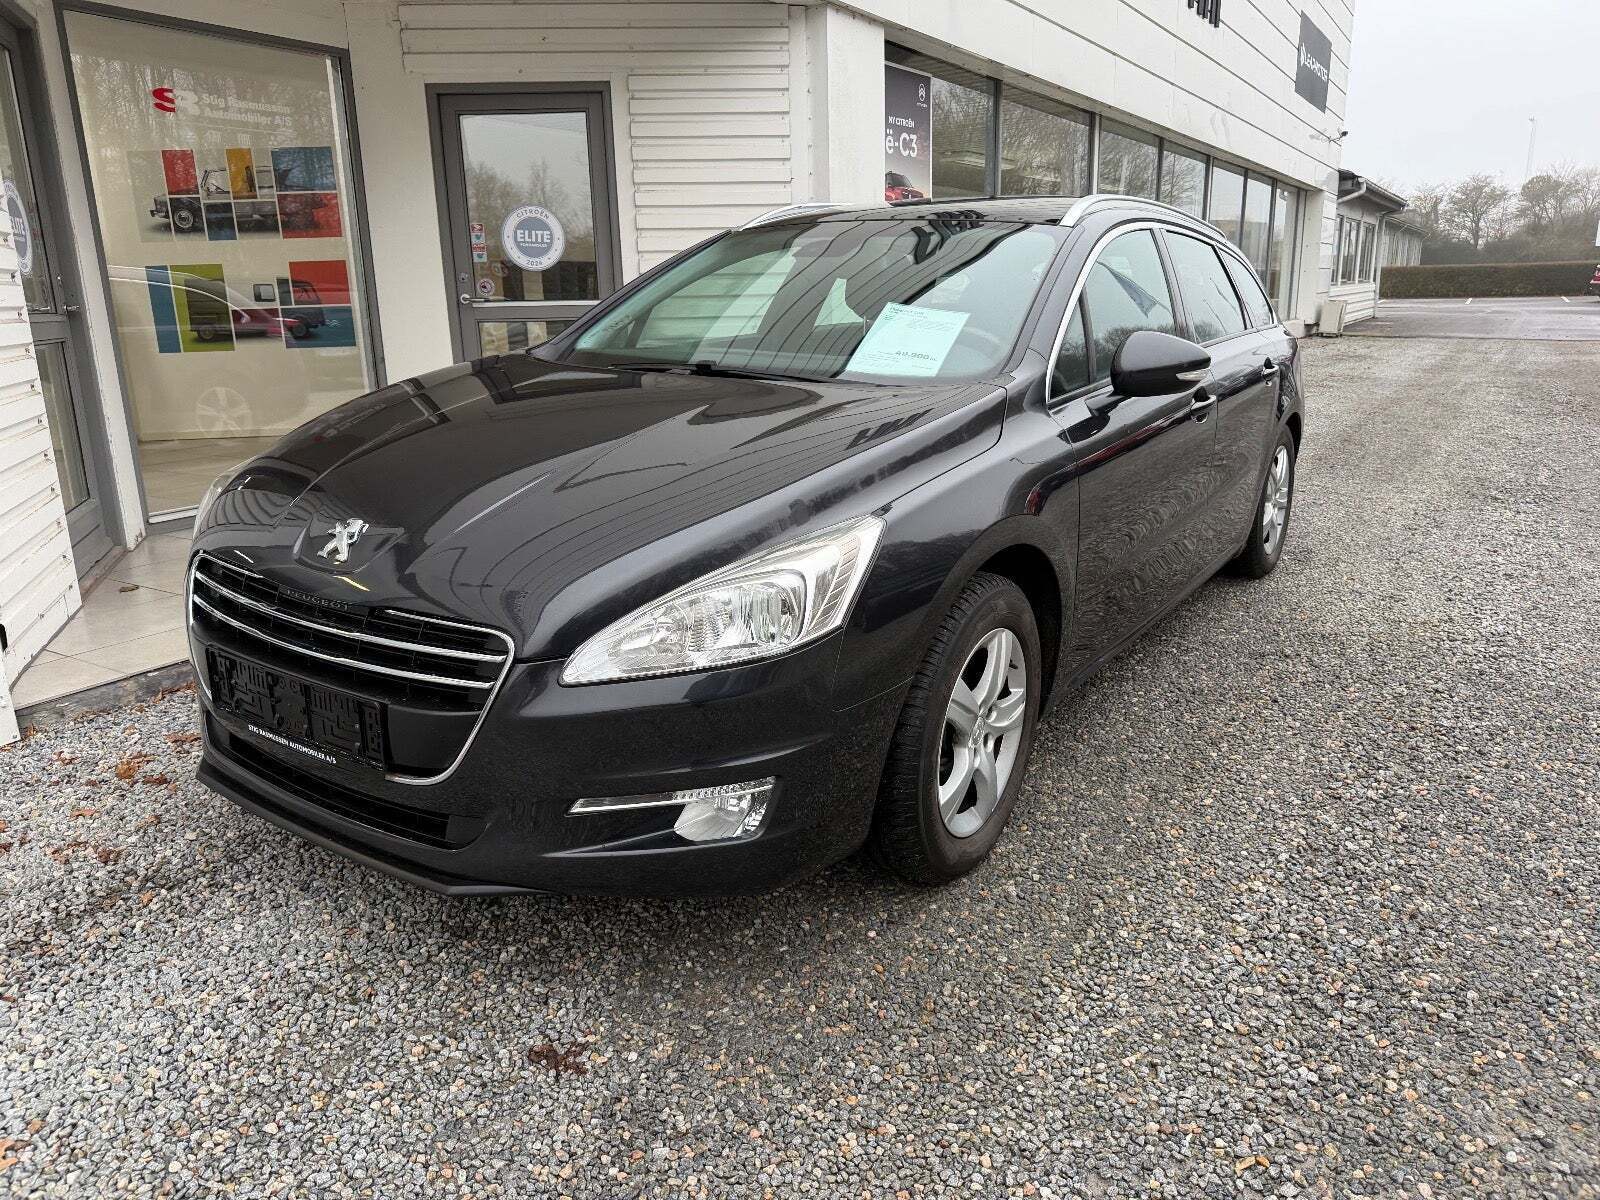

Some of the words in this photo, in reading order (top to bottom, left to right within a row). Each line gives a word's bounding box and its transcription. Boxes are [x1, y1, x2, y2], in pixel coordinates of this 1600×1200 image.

[201, 94, 225, 107] Stig
[227, 96, 291, 115] Rasmussen
[204, 106, 272, 126] Automobiler
[274, 114, 293, 127] A/S
[885, 129, 918, 158] ë-C3
[516, 229, 551, 242] ELITE
[247, 724, 259, 734] STIG
[259, 728, 289, 747] RASMUSSEN
[289, 740, 326, 761] AUTOMOBILER
[326, 754, 337, 764] A/S
